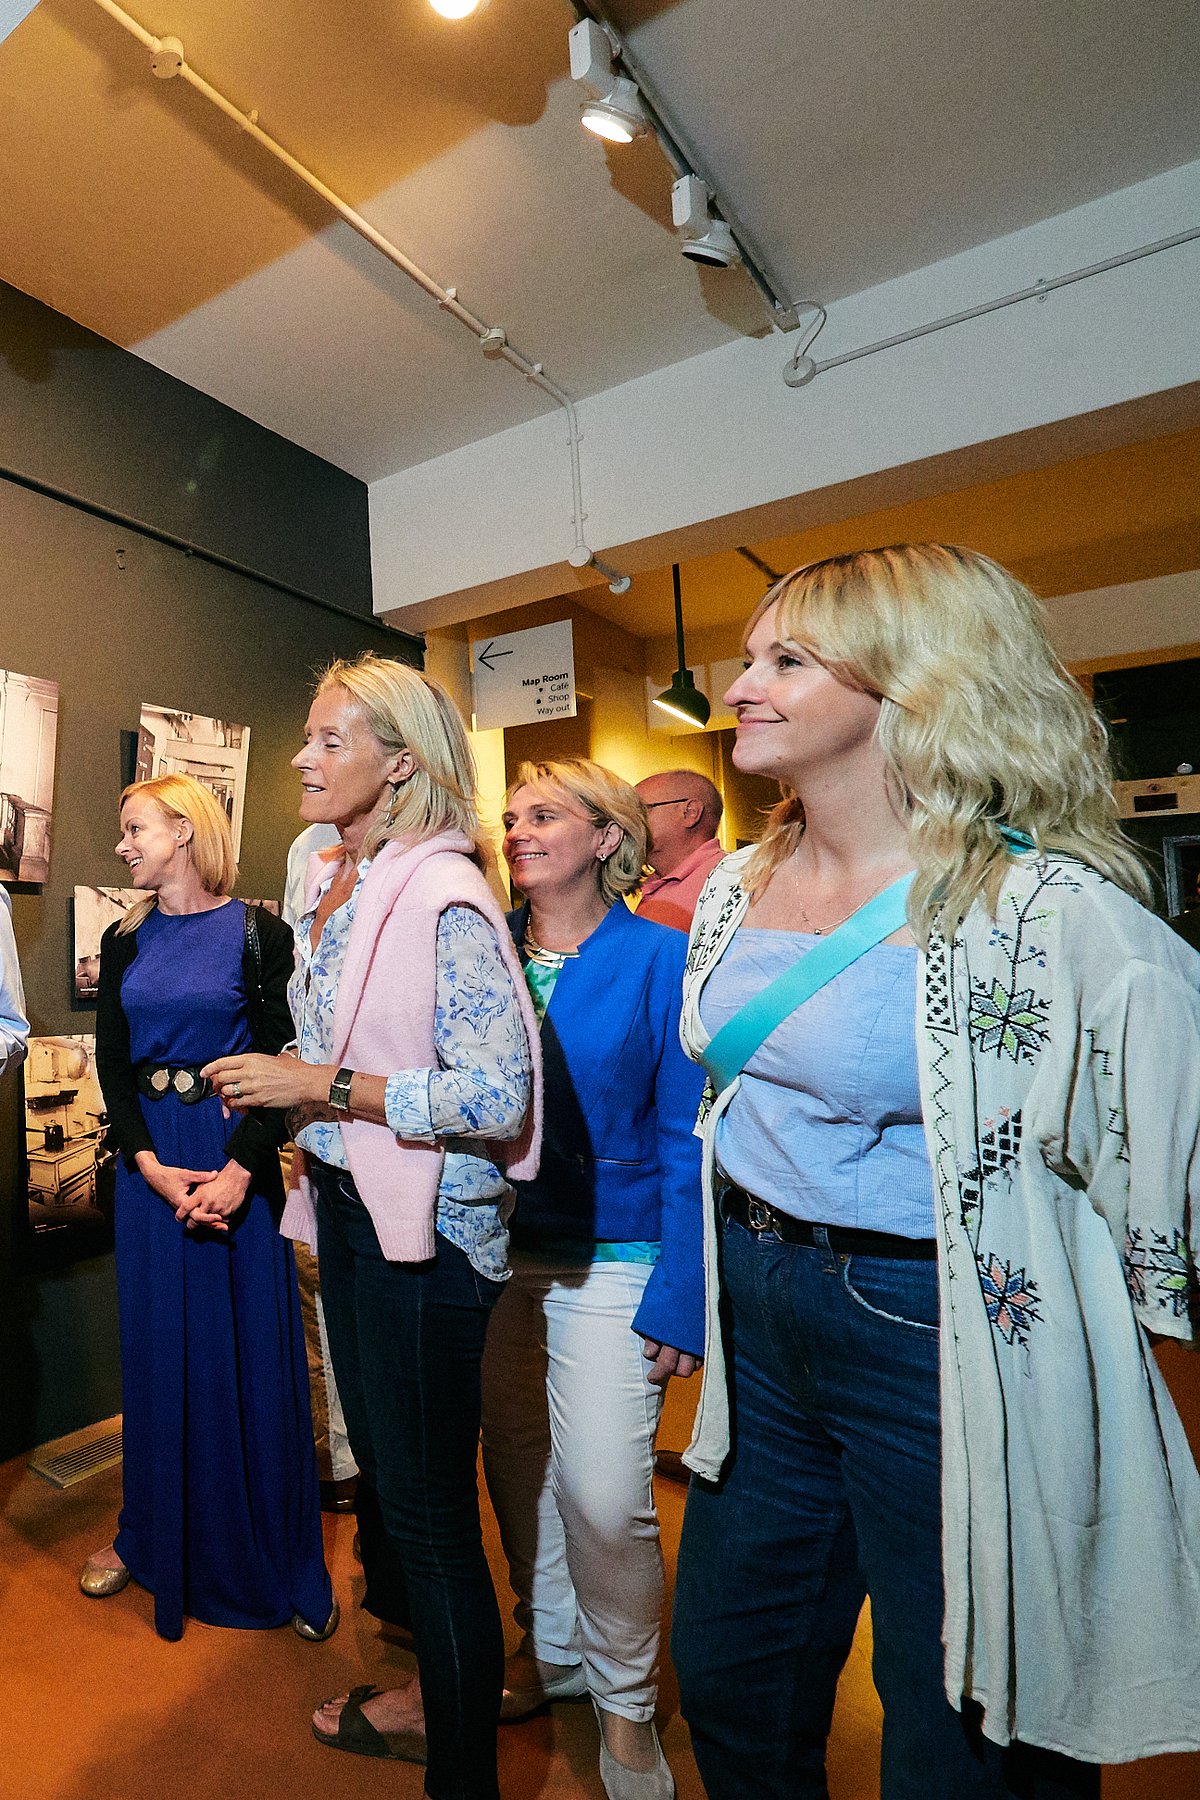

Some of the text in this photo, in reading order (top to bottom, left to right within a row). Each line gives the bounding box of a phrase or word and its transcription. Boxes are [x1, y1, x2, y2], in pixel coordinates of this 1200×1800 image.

[522, 673, 569, 687] Map Room
[550, 682, 569, 692] Café
[548, 694, 570, 703] Shop
[537, 704, 570, 715] Way out
